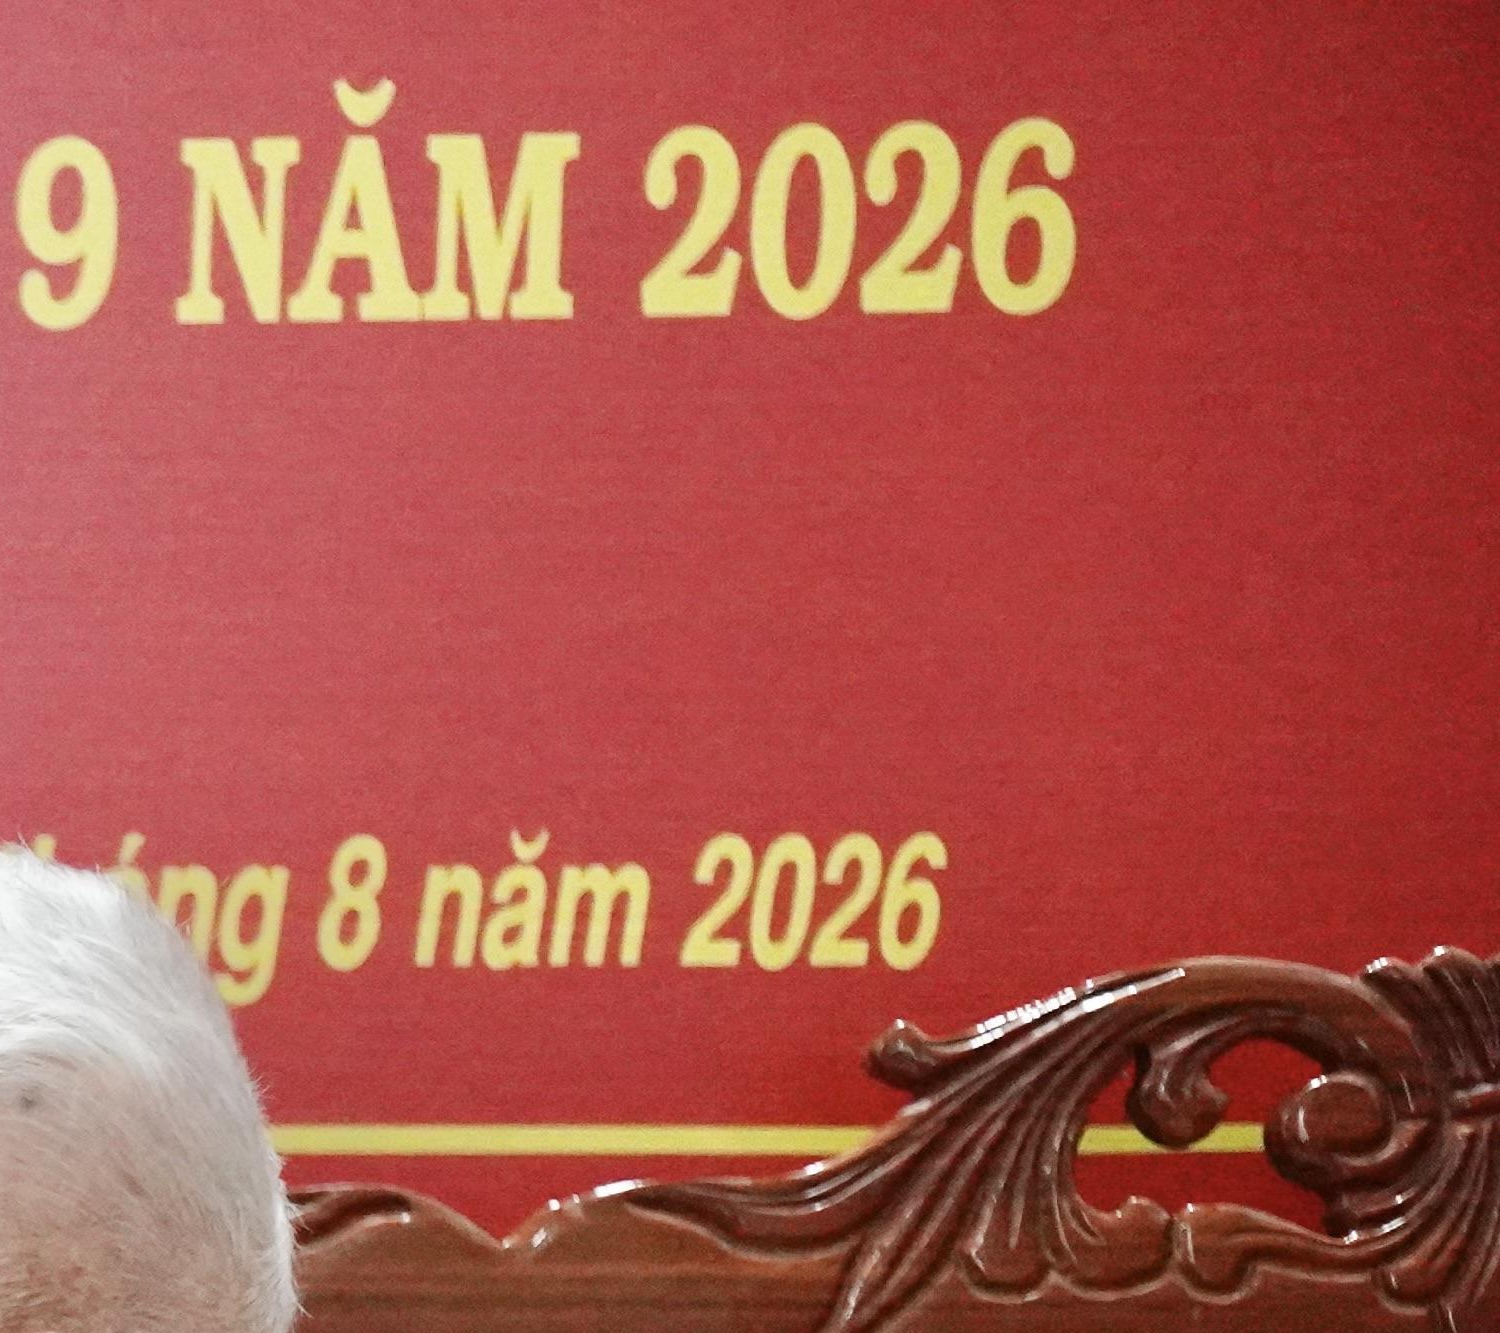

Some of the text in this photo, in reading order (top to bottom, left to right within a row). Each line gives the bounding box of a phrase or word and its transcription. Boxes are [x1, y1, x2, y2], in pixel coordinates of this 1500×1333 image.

[14, 134, 120, 332] 9
[173, 77, 582, 327] NĂM
[637, 115, 1078, 322] 2026
[315, 832, 389, 973] 8
[412, 828, 652, 972] năm
[677, 830, 949, 973] 2026
